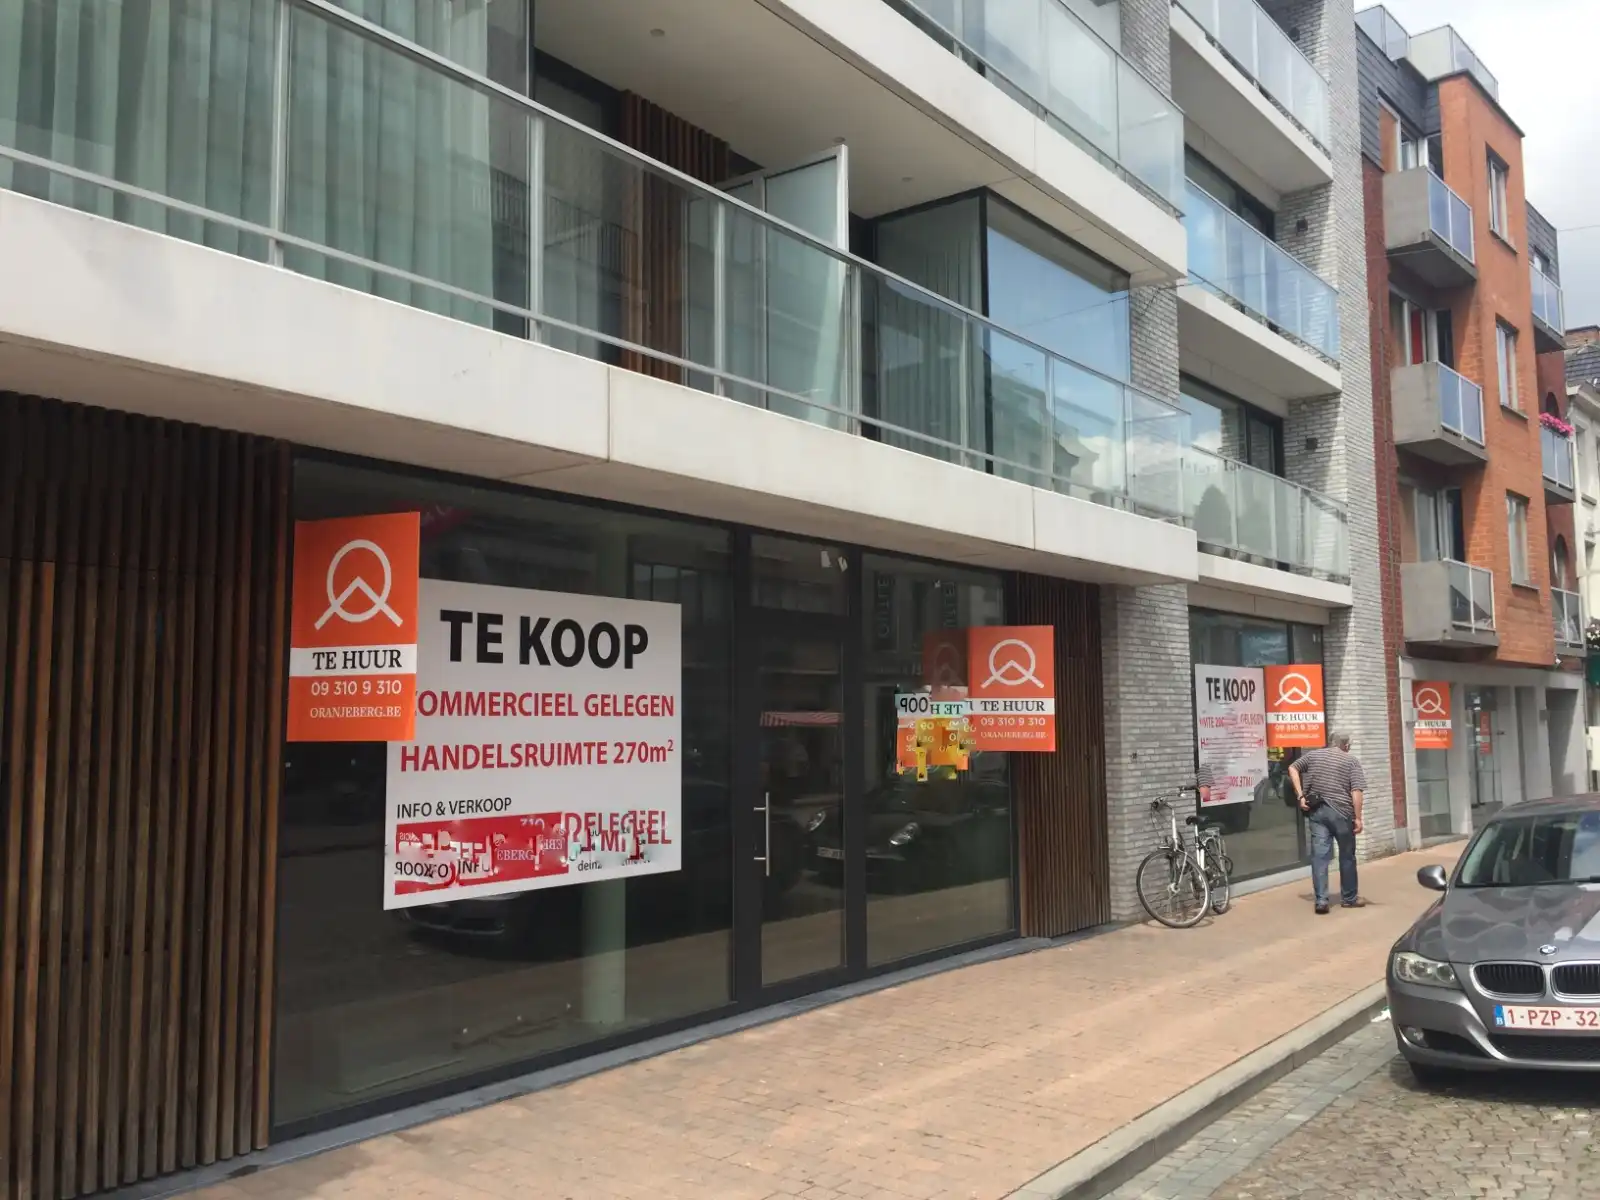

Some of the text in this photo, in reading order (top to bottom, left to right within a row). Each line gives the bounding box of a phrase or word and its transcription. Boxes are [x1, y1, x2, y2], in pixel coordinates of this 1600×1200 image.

[440, 609, 648, 669] TE KOOP
[312, 649, 402, 670] TE HUUR
[311, 680, 402, 696] 09 310 9 310
[1206, 677, 1255, 702] TE KOOP
[310, 706, 402, 719] ORANJEBERG.BE
[414, 690, 674, 717] OMMERCIEEL GELEGEN
[980, 700, 1046, 712] TE HUUR
[981, 717, 994, 726] 09
[997, 717, 1015, 726] 310
[1018, 717, 1025, 726] 9
[1028, 717, 1046, 726] 310
[401, 742, 607, 772] HANDELSRUIMTE
[397, 797, 512, 819] INFO & VERKOOP
